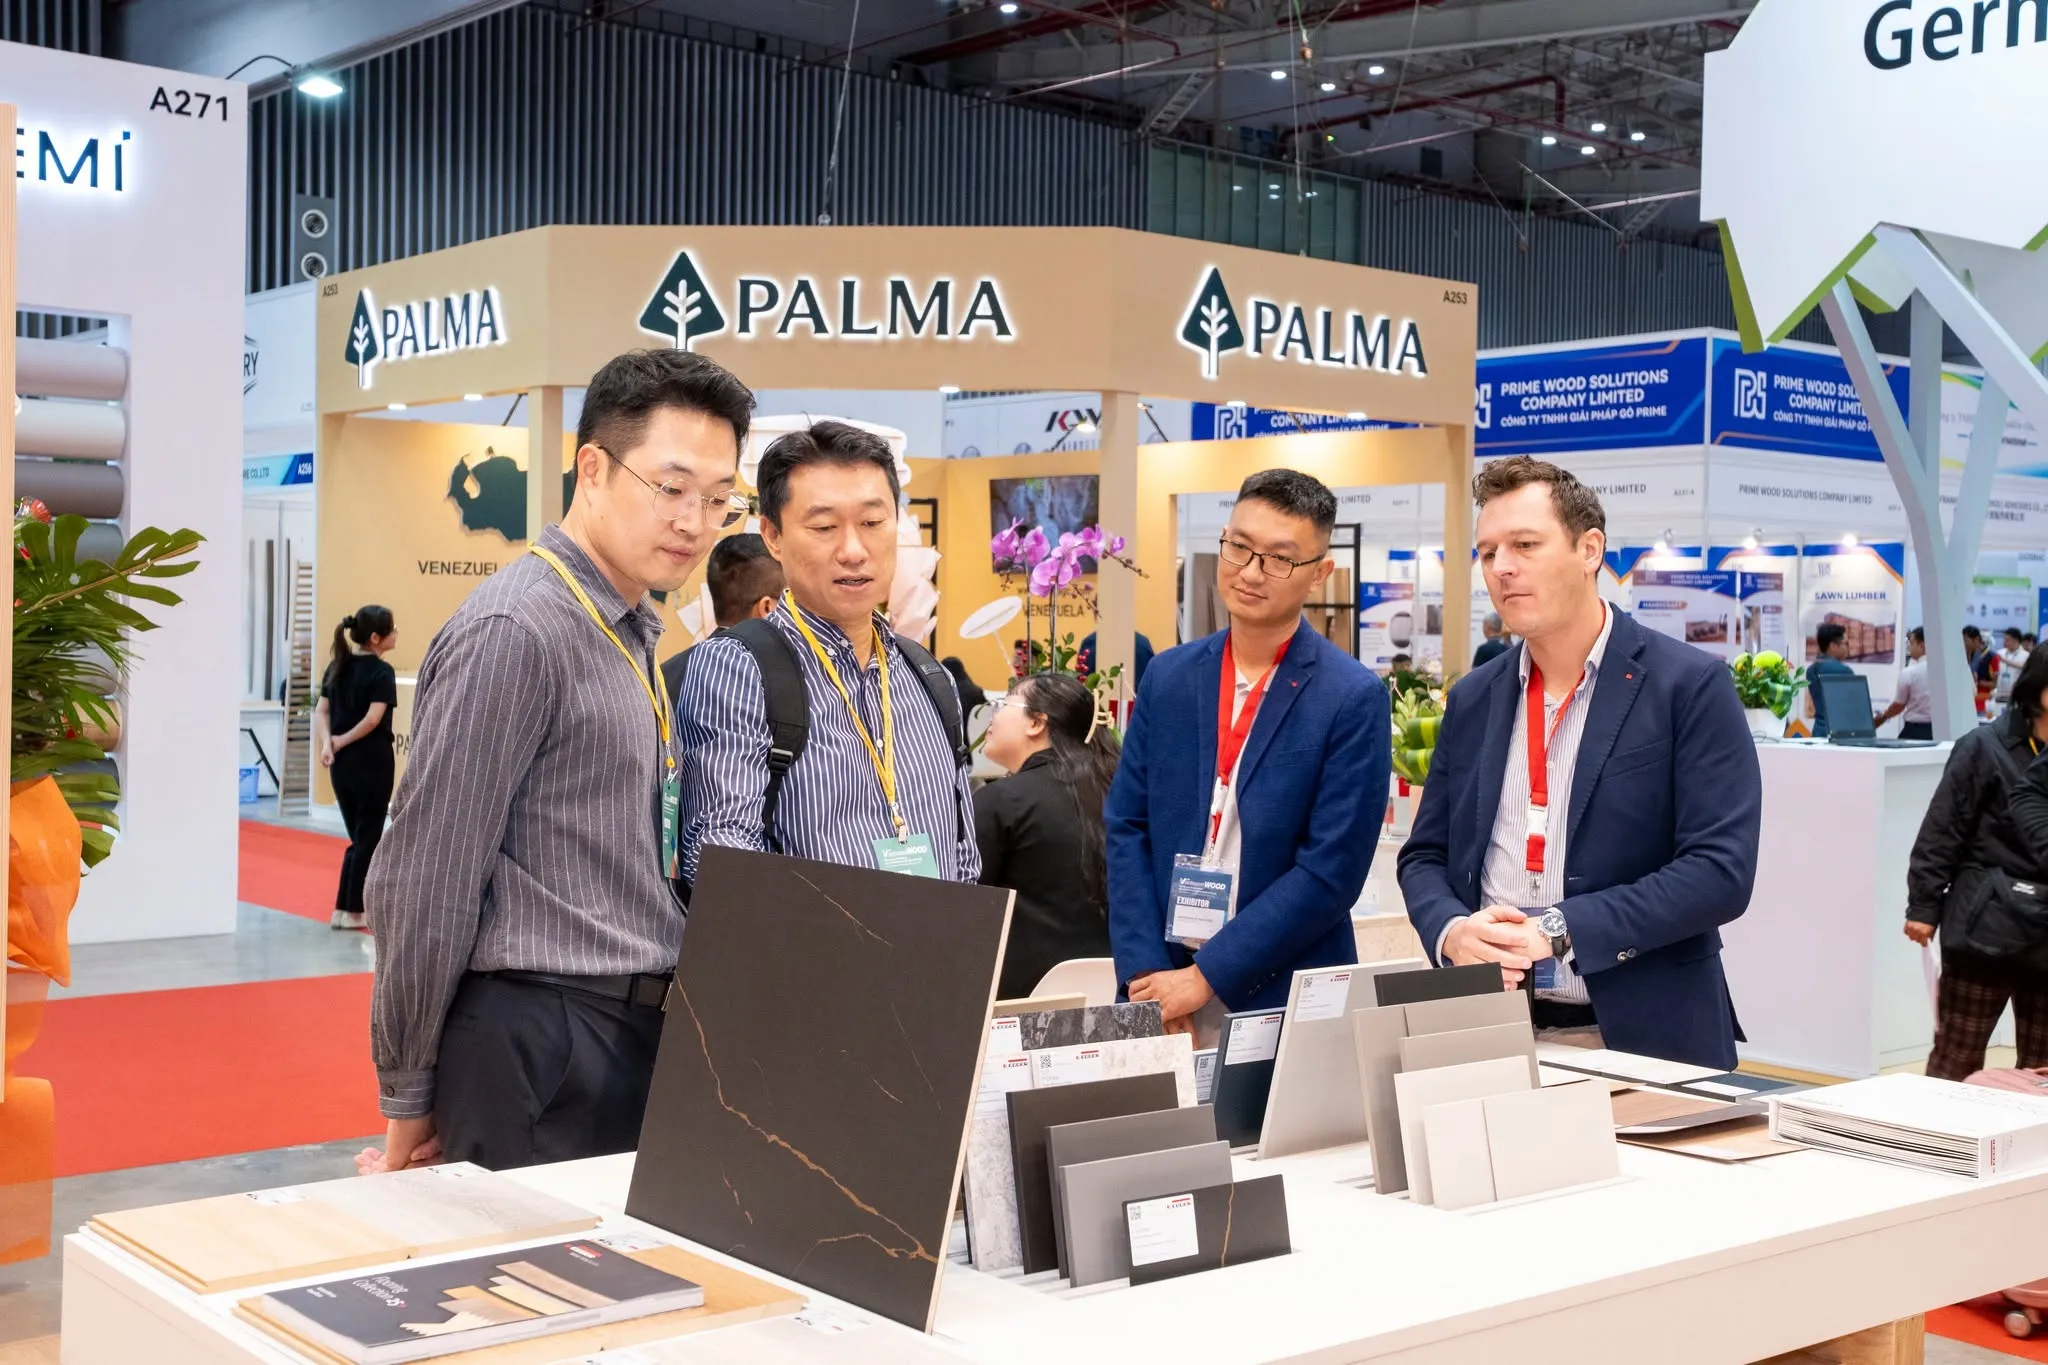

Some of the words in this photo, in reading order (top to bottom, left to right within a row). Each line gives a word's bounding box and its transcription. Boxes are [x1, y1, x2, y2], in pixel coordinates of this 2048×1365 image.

[150, 86, 228, 121] A271
[1443, 290, 1468, 304] A253
[737, 278, 1013, 337] PALMA
[382, 288, 502, 360] PALMA
[1251, 300, 1429, 375] PALMA
[1501, 380, 1541, 396] PRIME
[1543, 376, 1587, 393] WOOD
[1589, 369, 1669, 389] SOLUTIONS
[1773, 374, 1804, 392] PRIME
[1806, 379, 1837, 396] WOOD
[1520, 391, 1587, 411] COMPANY
[1589, 387, 1645, 405] LIMITED
[1789, 393, 1837, 413] COMPANY
[1527, 415, 1541, 425] TY
[1636, 405, 1668, 418] PRIME
[1341, 494, 1371, 504] LIMITED
[1610, 484, 1647, 494] LIMITED
[1739, 484, 1760, 496] PRIME
[1760, 486, 1781, 498] WOOD
[1782, 488, 1818, 500] SOLUTIONS
[1819, 491, 1848, 503] COMPANY
[1815, 591, 1843, 600] SAWN
[1846, 591, 1886, 600] LUMBER
[1176, 896, 1210, 908] EXHIBITOR
